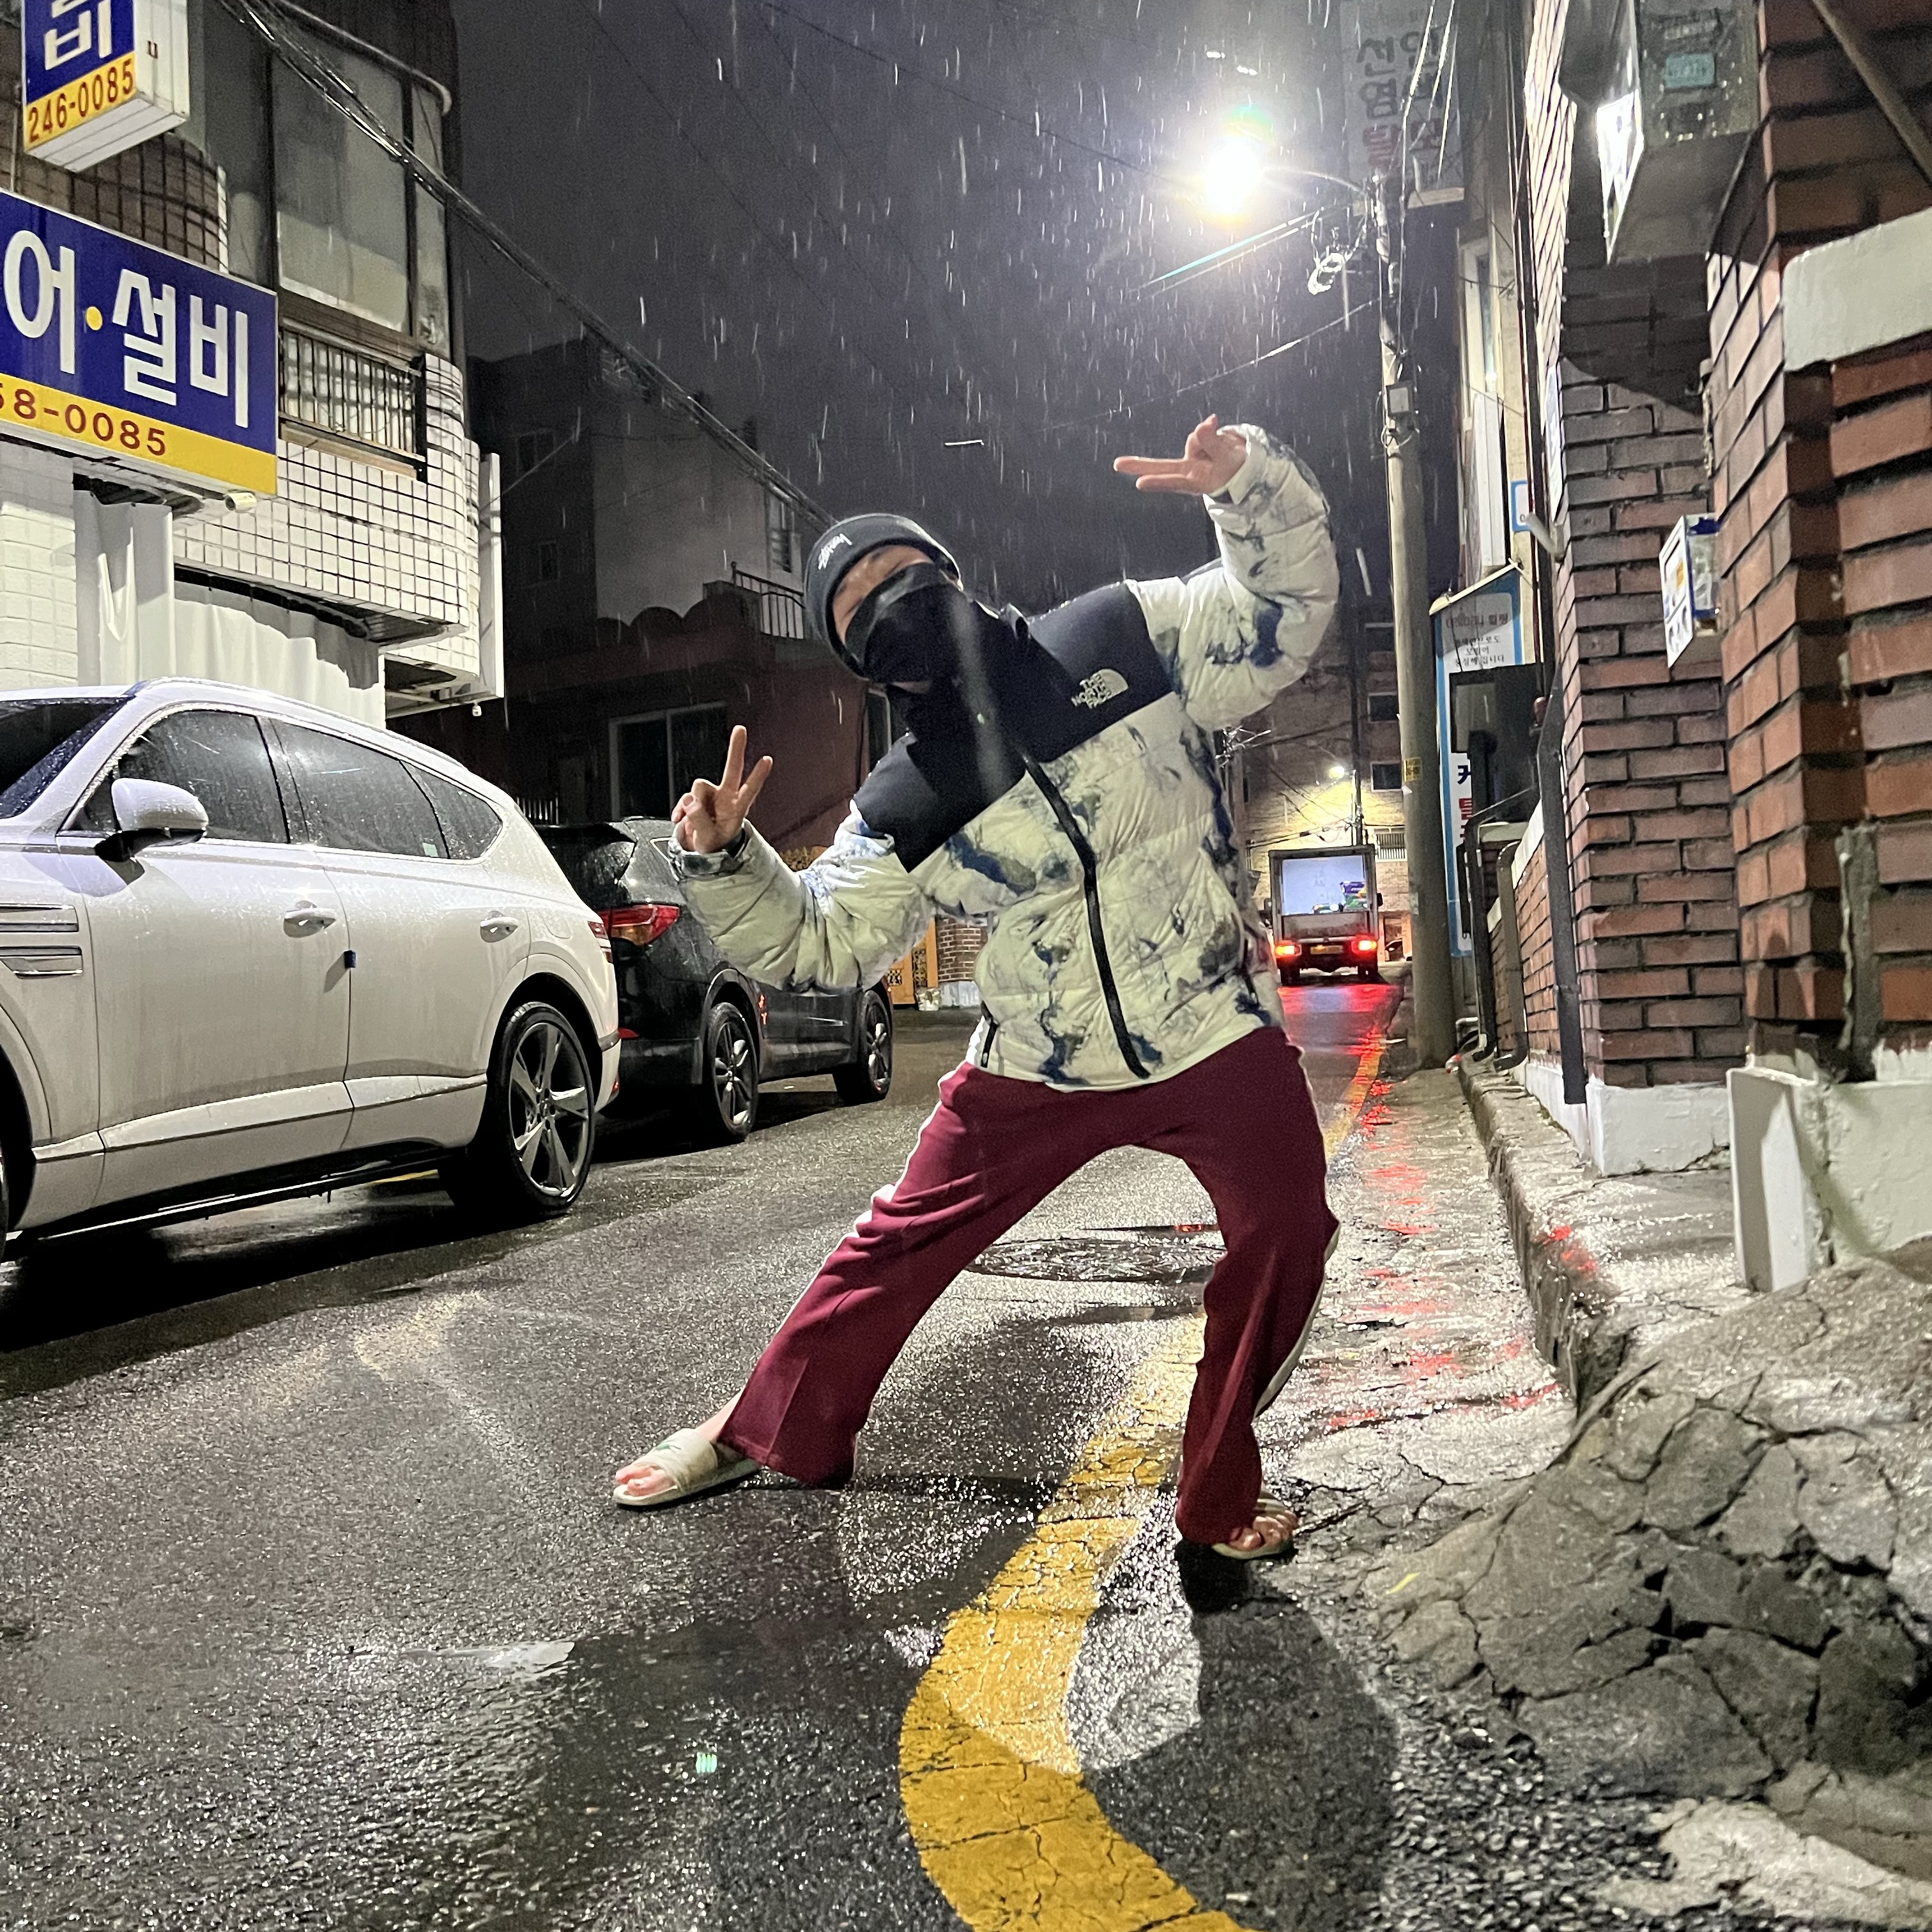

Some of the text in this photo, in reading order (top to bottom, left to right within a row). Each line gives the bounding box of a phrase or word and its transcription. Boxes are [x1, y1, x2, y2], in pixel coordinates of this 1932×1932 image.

[28, 58, 134, 144] 246-0085
[0, 383, 166, 456] 8-0085
[1079, 672, 1102, 691] THE
